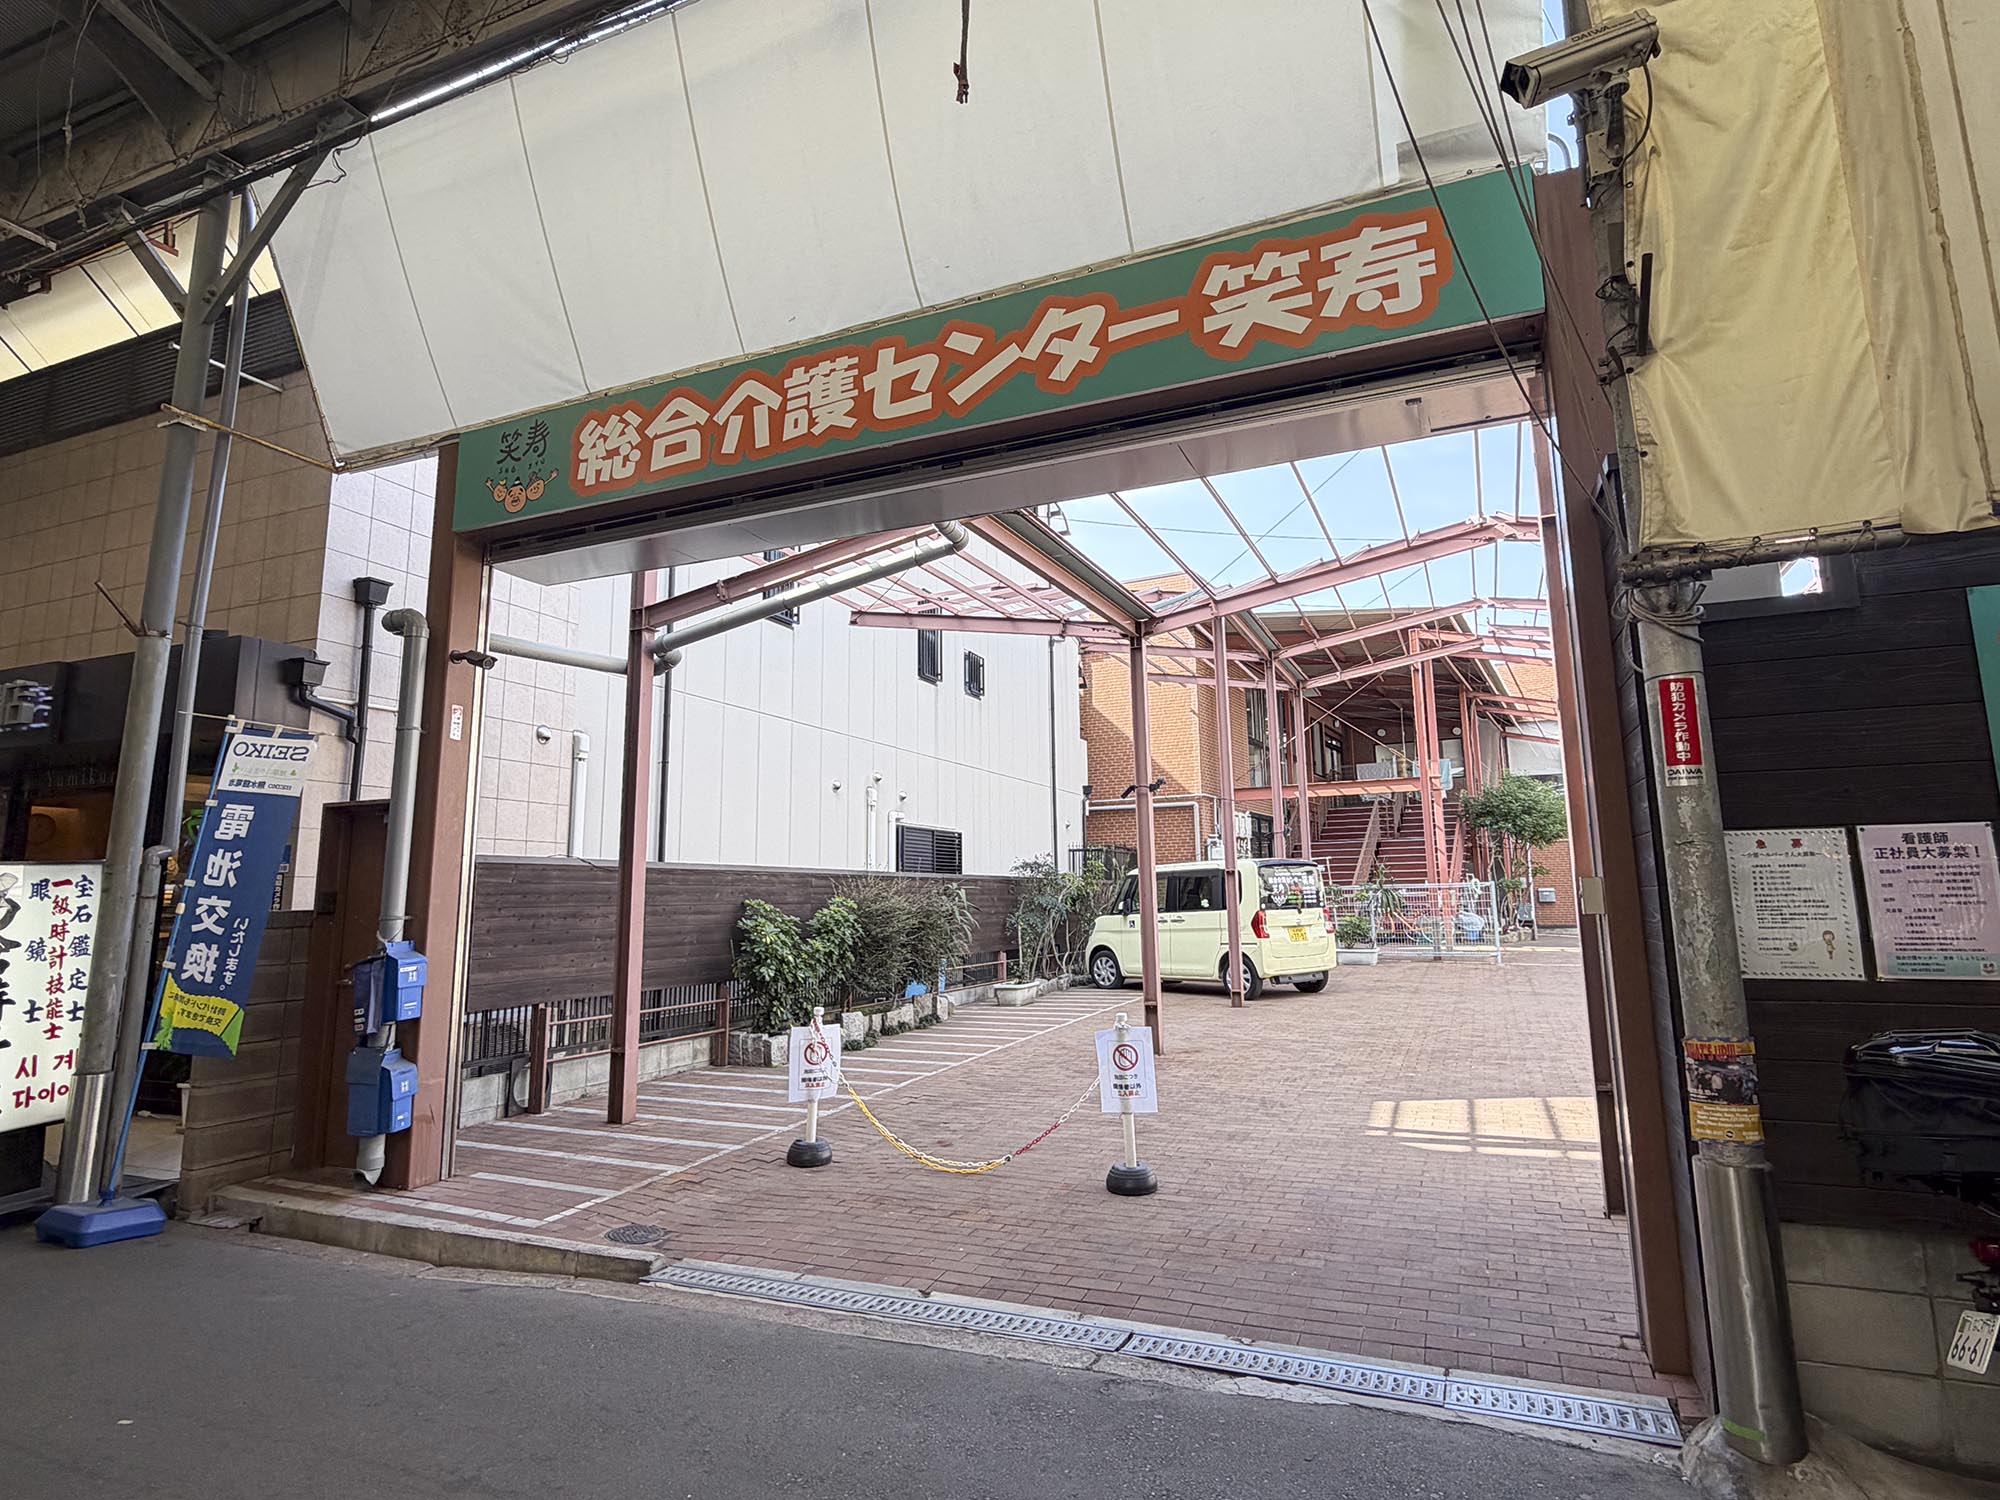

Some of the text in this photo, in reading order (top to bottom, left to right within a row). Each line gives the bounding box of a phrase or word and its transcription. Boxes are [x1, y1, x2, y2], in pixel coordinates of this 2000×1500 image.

[1572, 26, 1610, 42] DAIWA
[575, 220, 1437, 488] 総合介護センター笑寿
[496, 418, 550, 465] 笑寿
[1669, 681, 1691, 762] 防犯カメラ作動中
[1667, 768, 1703, 776] DAIWA
[1901, 831, 1949, 845] 看護師
[22, 877, 52, 1024] 眼鏡士
[41, 877, 74, 1041] 一級時計技能士
[66, 874, 95, 1023] 宝石鑑定士
